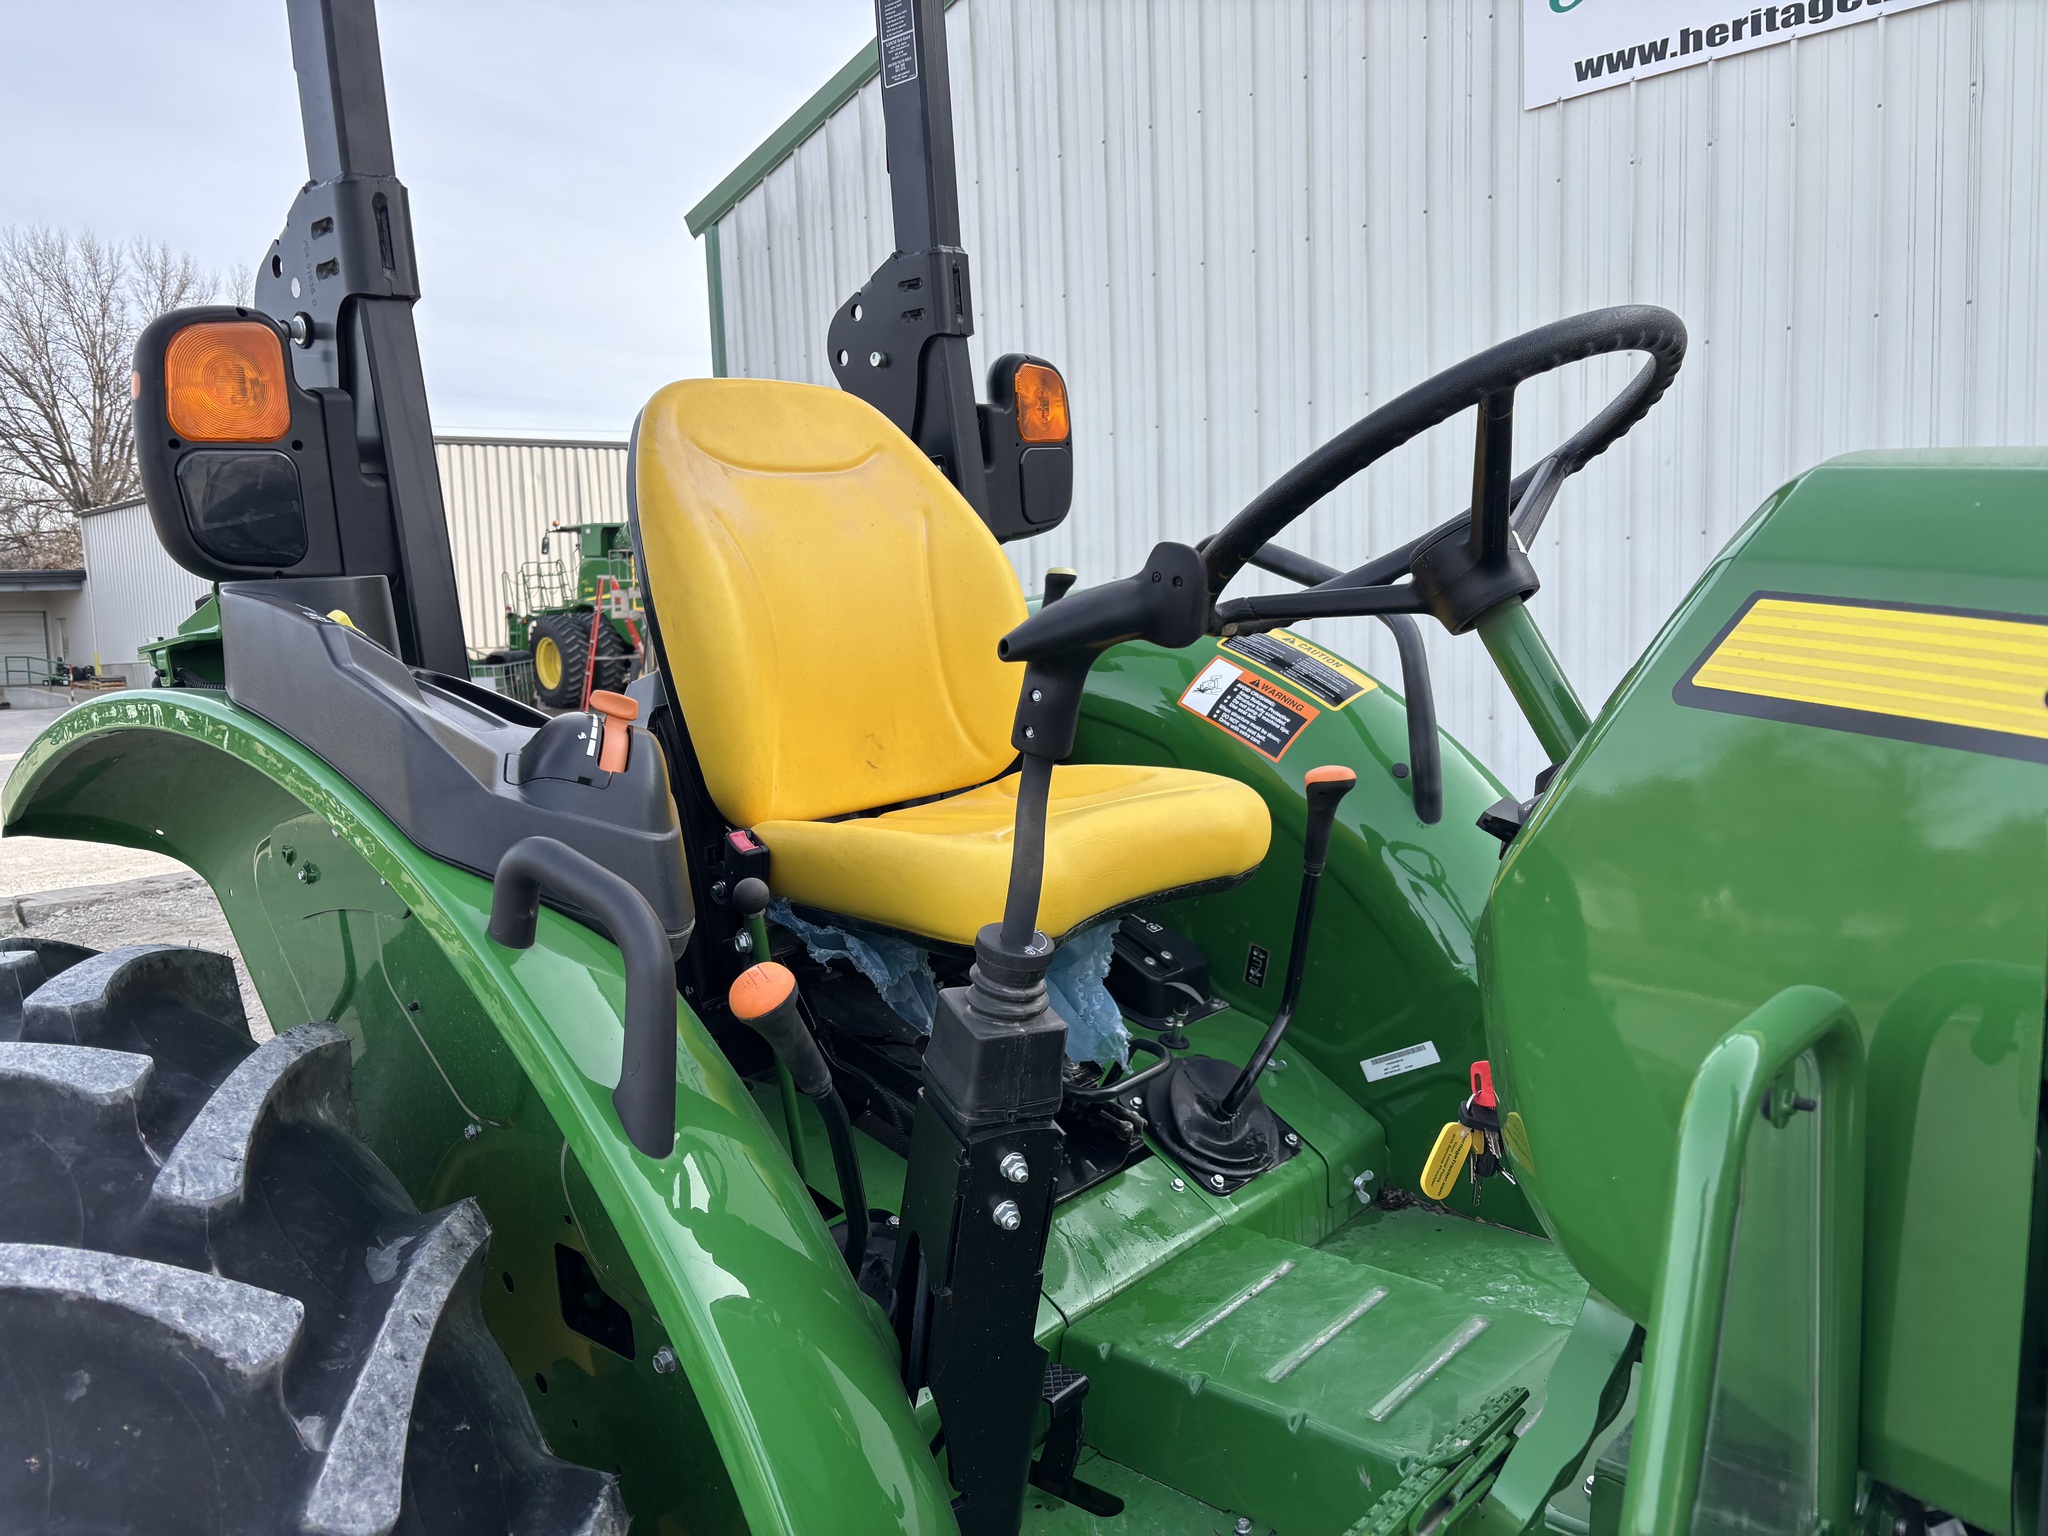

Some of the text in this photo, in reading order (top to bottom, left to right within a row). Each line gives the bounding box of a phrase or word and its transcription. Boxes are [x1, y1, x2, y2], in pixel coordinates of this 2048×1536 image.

[1574, 0, 1892, 82] www.heritag
[1298, 643, 1343, 668] CAUTION
[1236, 682, 1252, 693] AVOID
[1261, 683, 1304, 712] WARNING
[1218, 704, 1232, 714] When
[1250, 722, 1262, 731] must
[1239, 691, 1251, 699] Keep
[1268, 707, 1291, 722] Protective
[1218, 717, 1231, 726] Drive
[1229, 724, 1240, 732] with
[1239, 729, 1251, 738] extra
[1228, 717, 1239, 725] NOT
[1246, 728, 1257, 736] seat
[1261, 715, 1281, 728] machine
